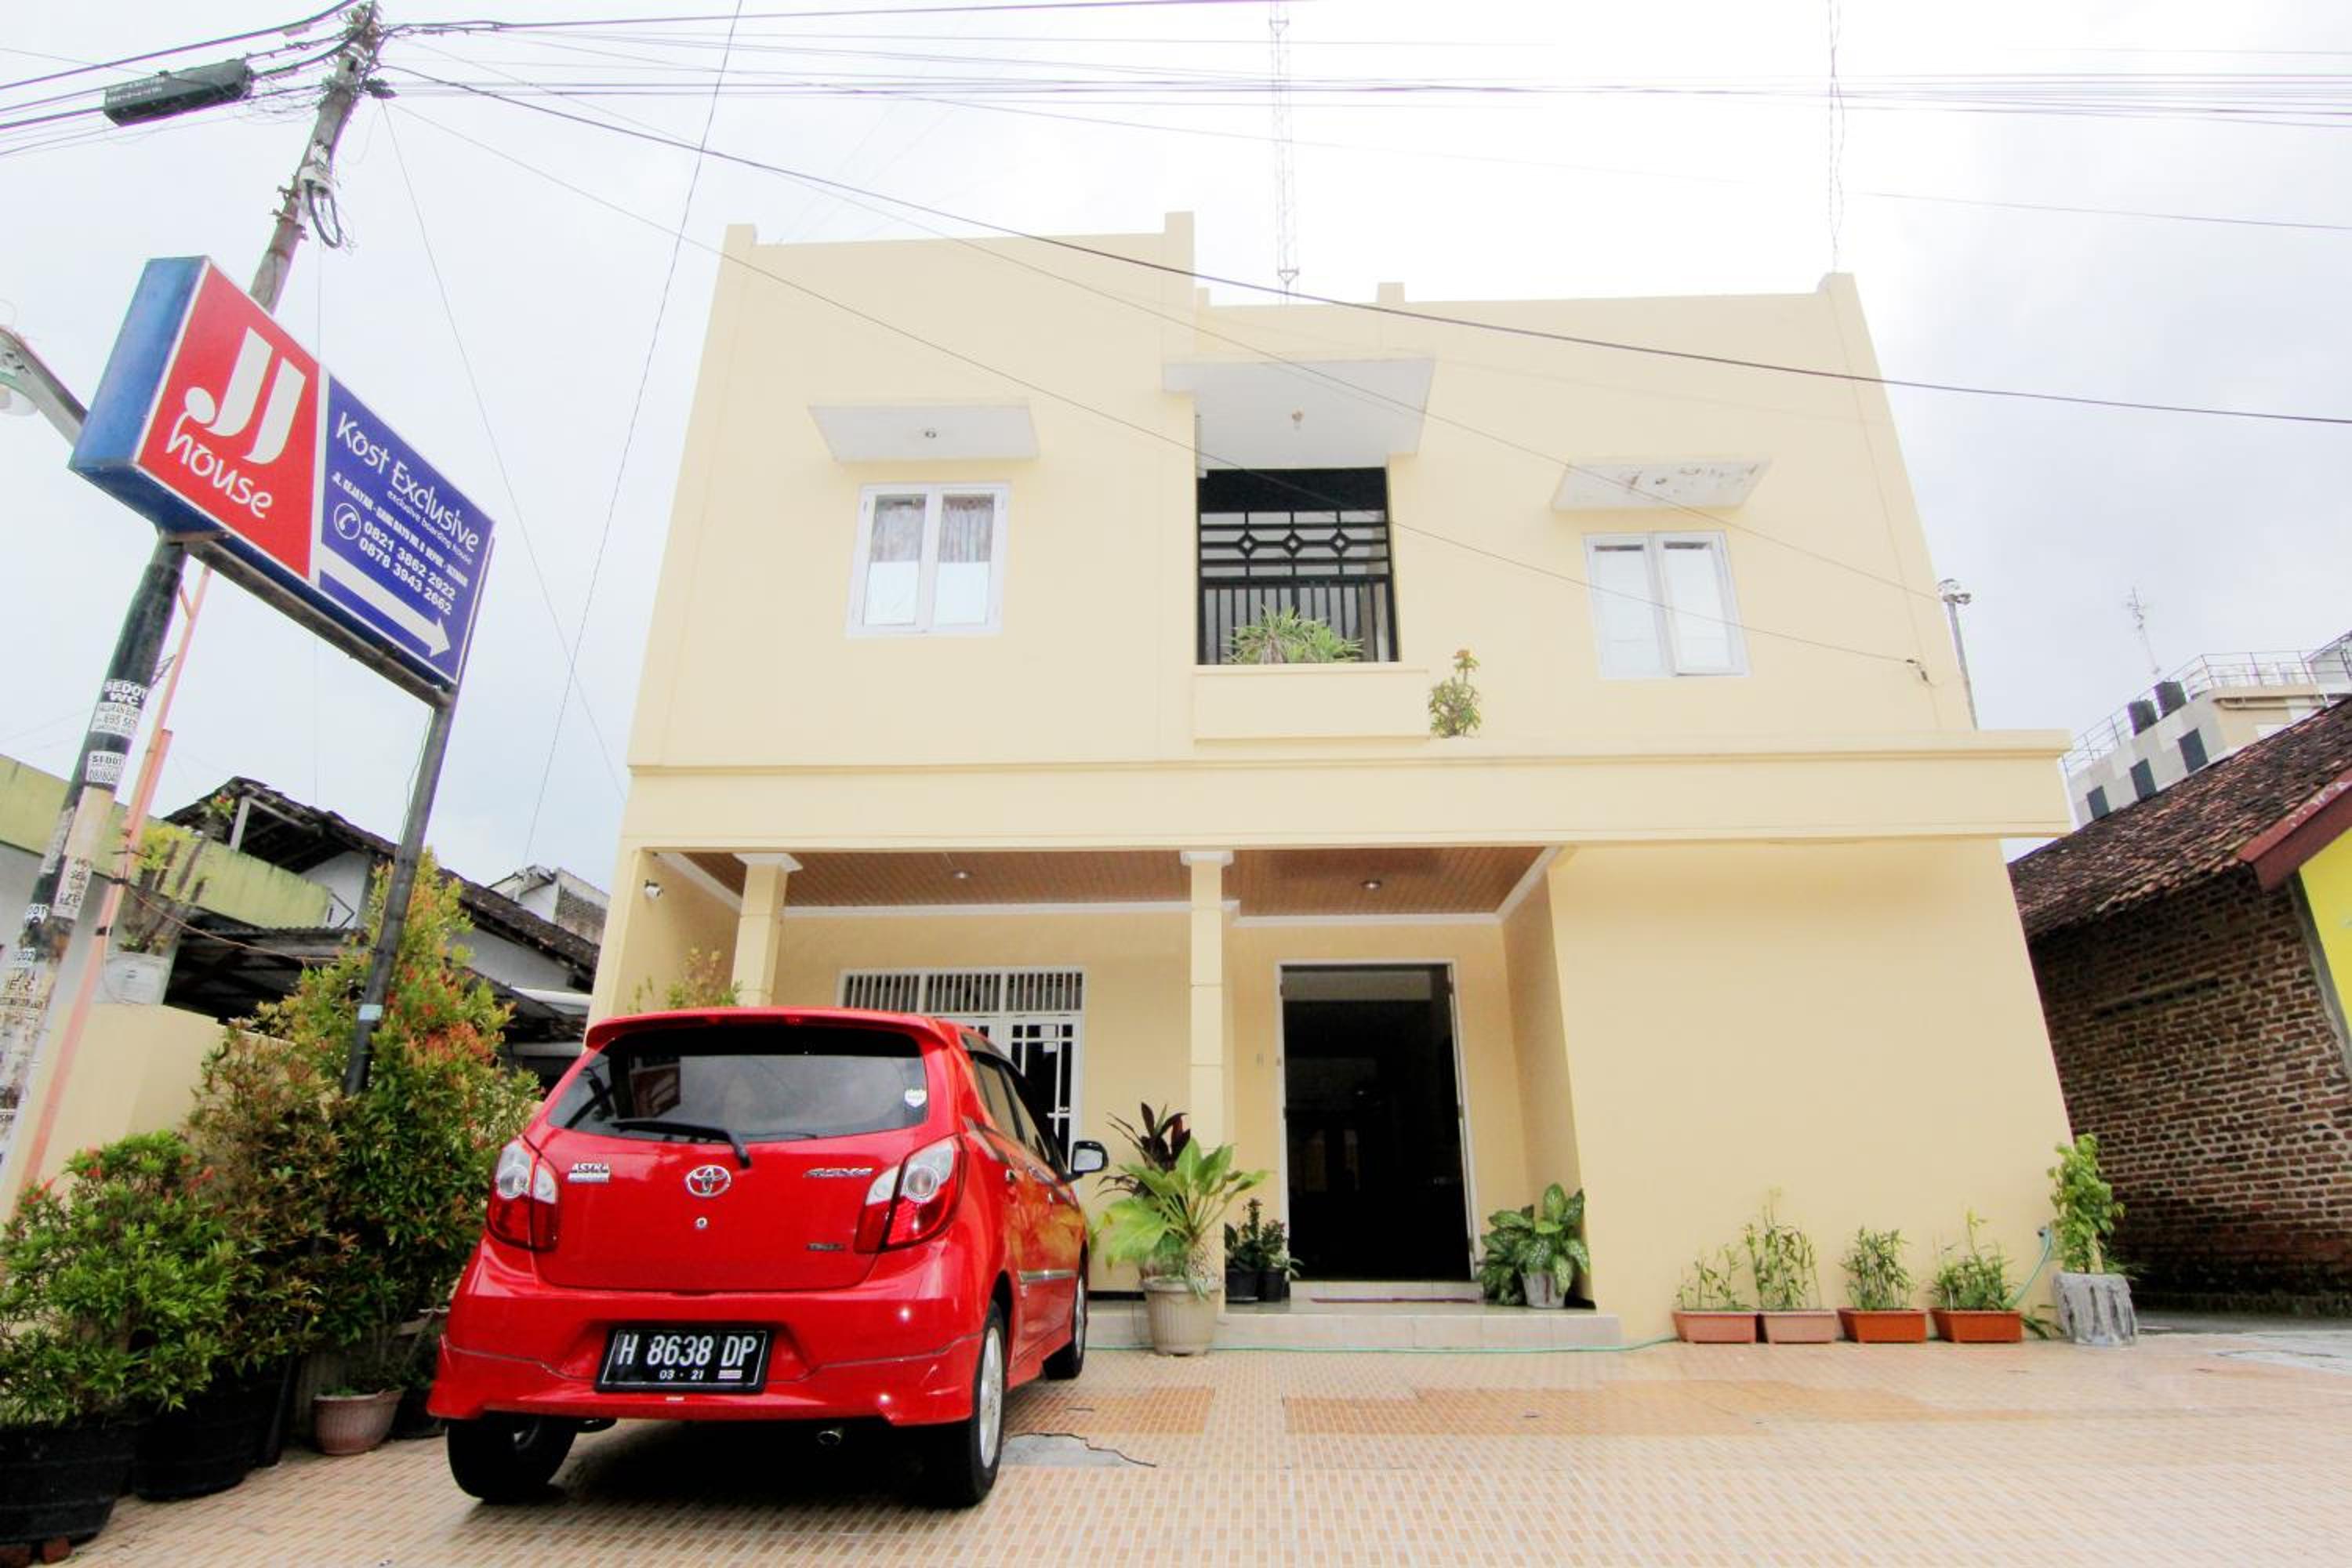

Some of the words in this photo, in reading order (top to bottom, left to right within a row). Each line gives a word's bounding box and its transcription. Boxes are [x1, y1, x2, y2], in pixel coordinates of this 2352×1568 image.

[165, 412, 273, 519] house
[336, 412, 390, 474] Kost
[392, 460, 479, 553] Exclusive
[359, 532, 391, 568] 0878
[393, 562, 423, 593] 3943
[364, 521, 394, 553] 0821
[397, 546, 427, 577] 3862
[109, 692, 140, 706] WC
[617, 1334, 639, 1366] H
[647, 1335, 713, 1367] 8638
[720, 1335, 757, 1367] DP
[659, 1370, 674, 1380] 03
[691, 1370, 704, 1380] 21
